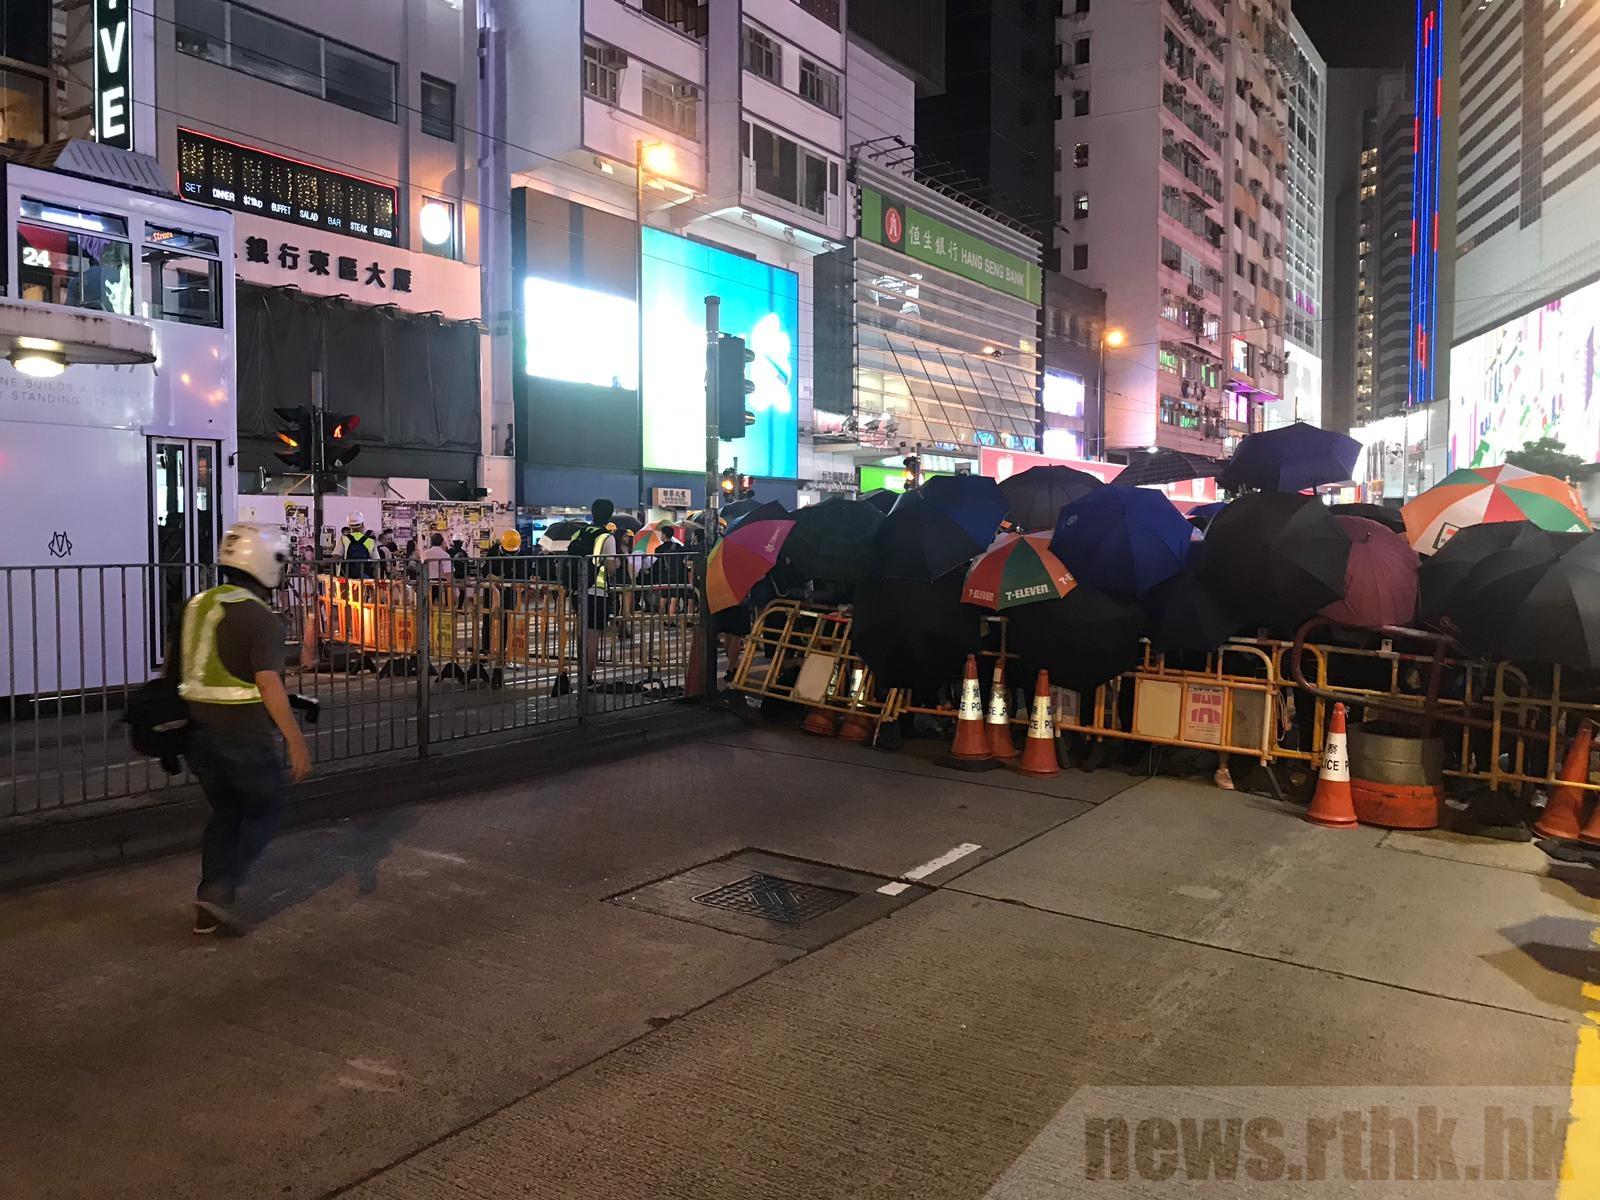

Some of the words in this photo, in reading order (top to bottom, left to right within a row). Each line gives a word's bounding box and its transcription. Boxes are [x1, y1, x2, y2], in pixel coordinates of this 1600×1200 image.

[100, 0, 126, 139] VE
[184, 182, 203, 194] SET
[212, 188, 235, 202] DINNER
[271, 203, 291, 215] BUFFET
[299, 209, 319, 222] SALAD
[327, 216, 342, 228] BAR
[350, 221, 368, 234] STEAK
[22, 246, 51, 268] 24
[234, 236, 412, 293] 銀行東區大廈
[909, 225, 959, 262] 恒生銀行
[961, 249, 983, 271] HANG
[984, 258, 1005, 279] SENG
[1005, 267, 1025, 288] BANK
[11, 390, 80, 406] STANDING
[25, 378, 73, 392] BUILDS
